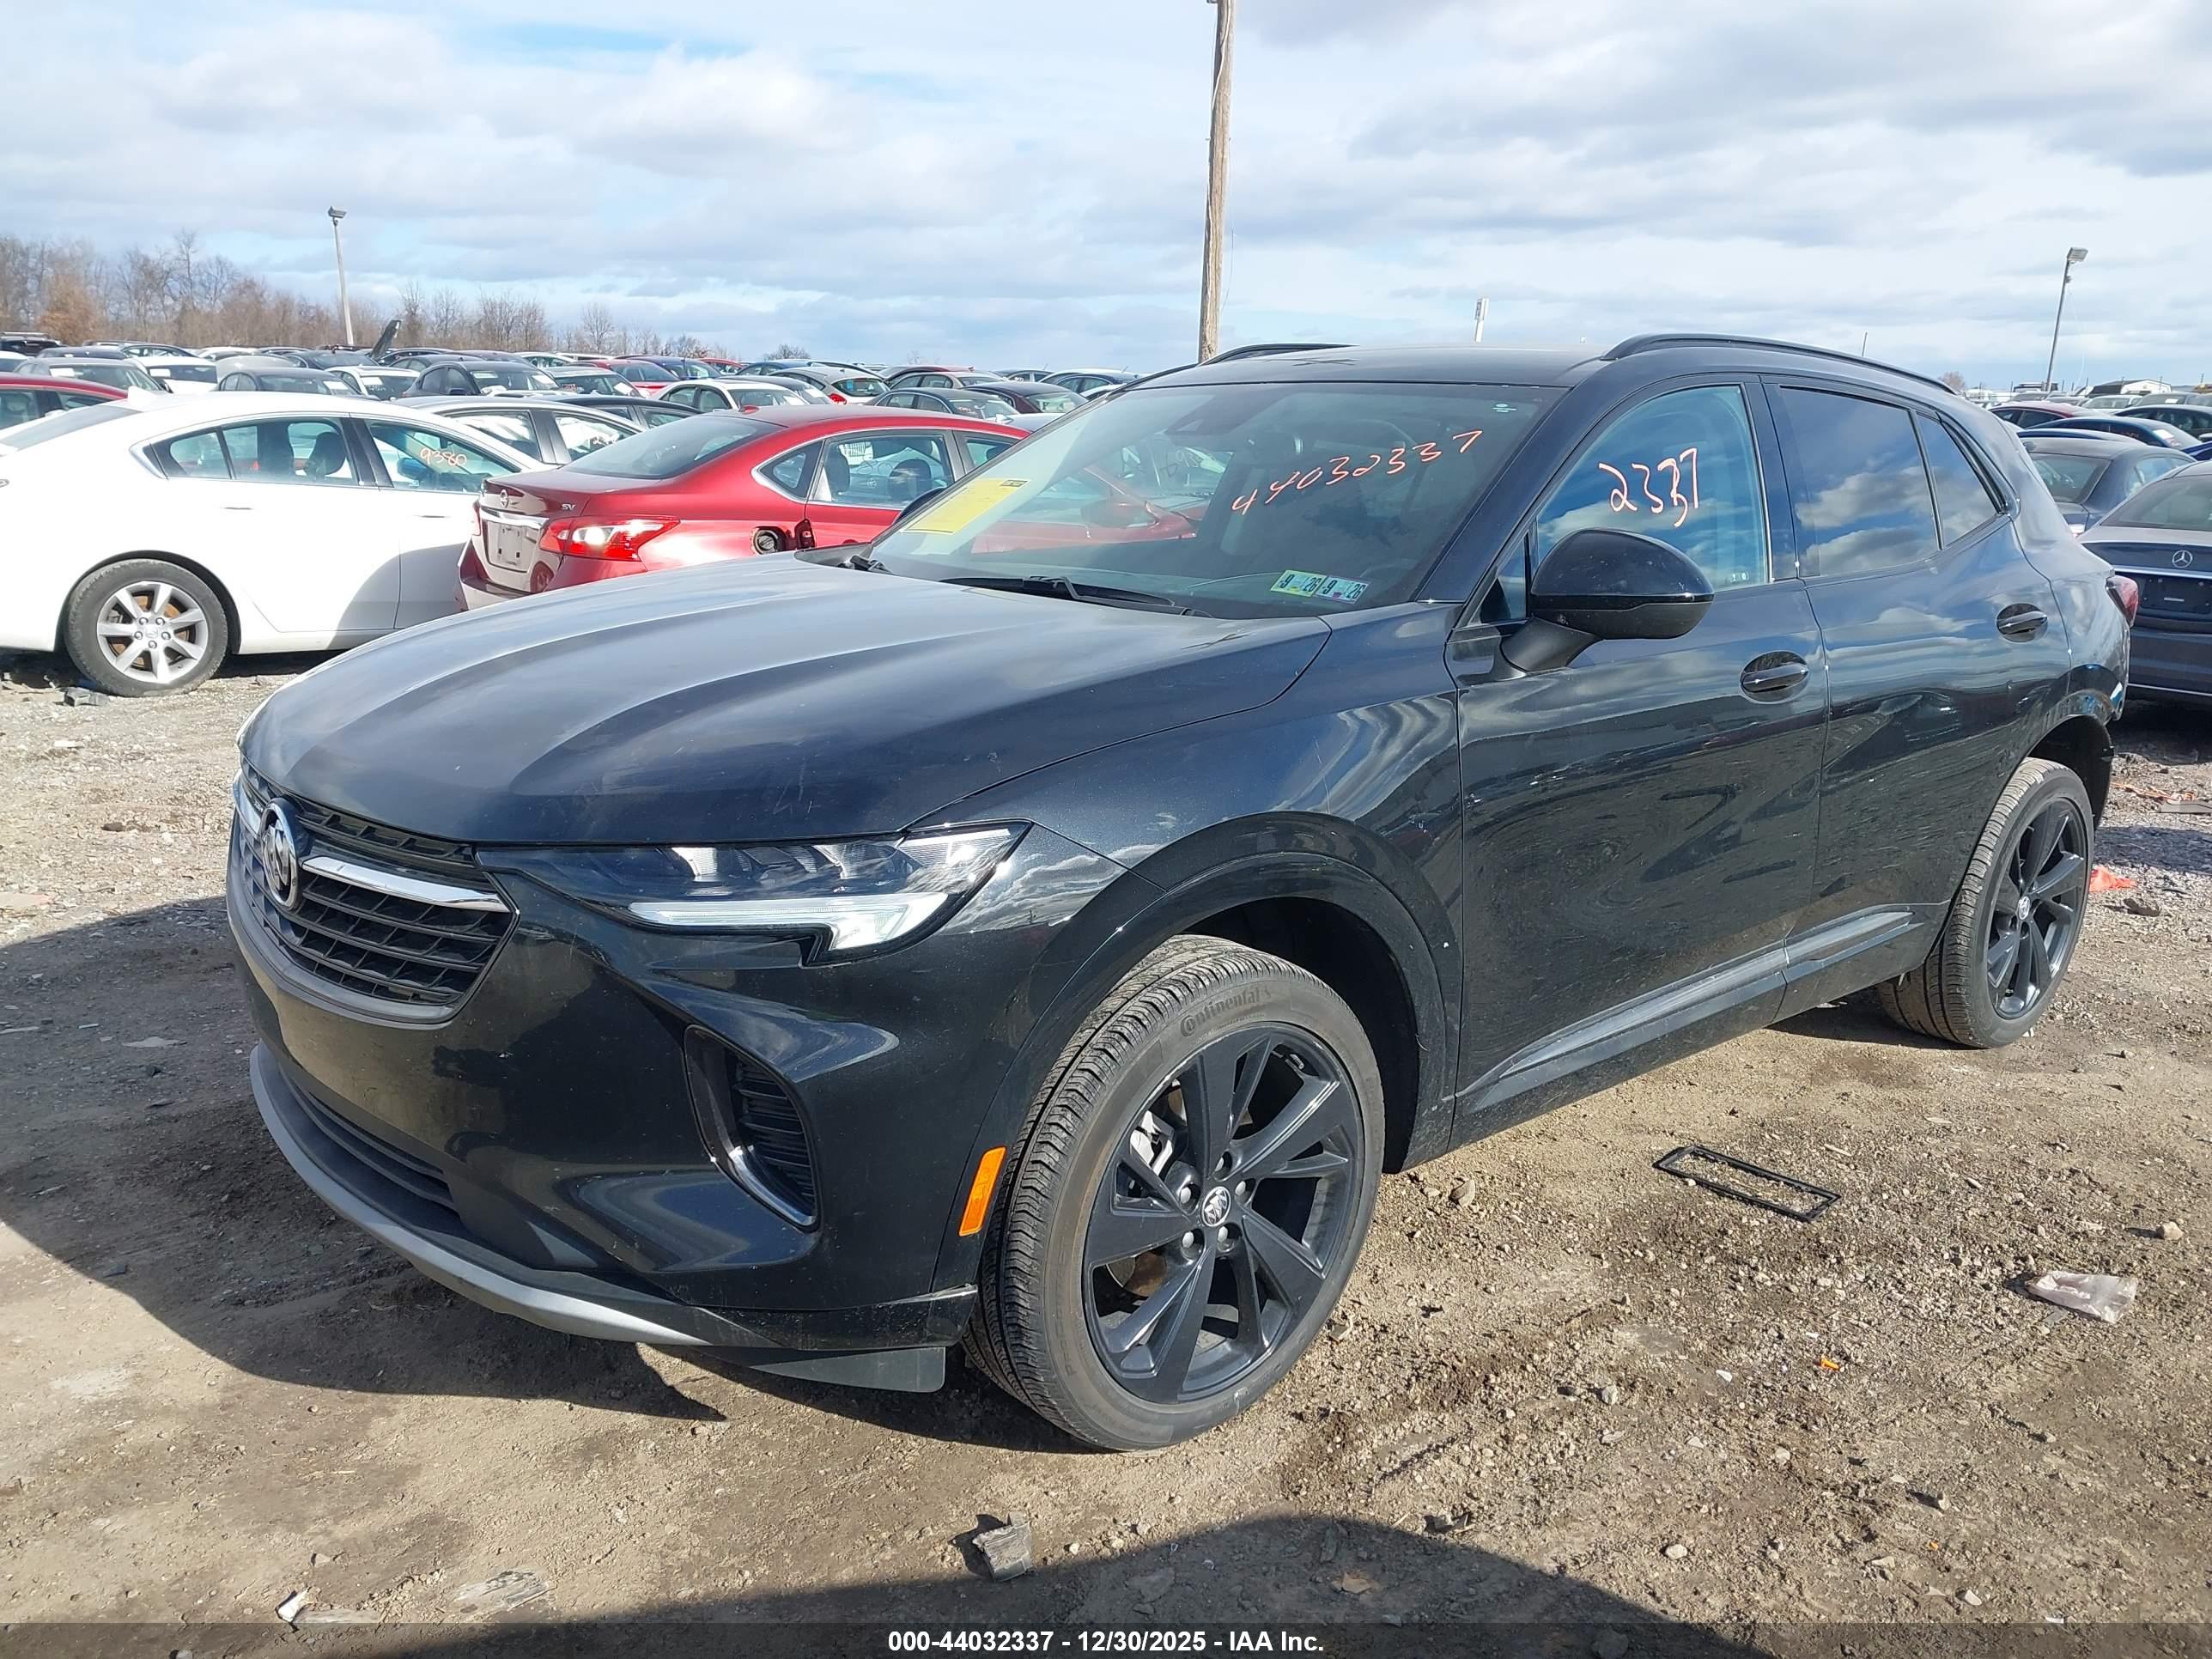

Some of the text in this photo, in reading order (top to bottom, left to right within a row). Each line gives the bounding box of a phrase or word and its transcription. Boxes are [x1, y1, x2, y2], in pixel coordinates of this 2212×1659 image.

[1231, 429, 1484, 516] 44032337
[1598, 447, 1699, 528] 2337
[1180, 987, 1260, 1037] Continental
